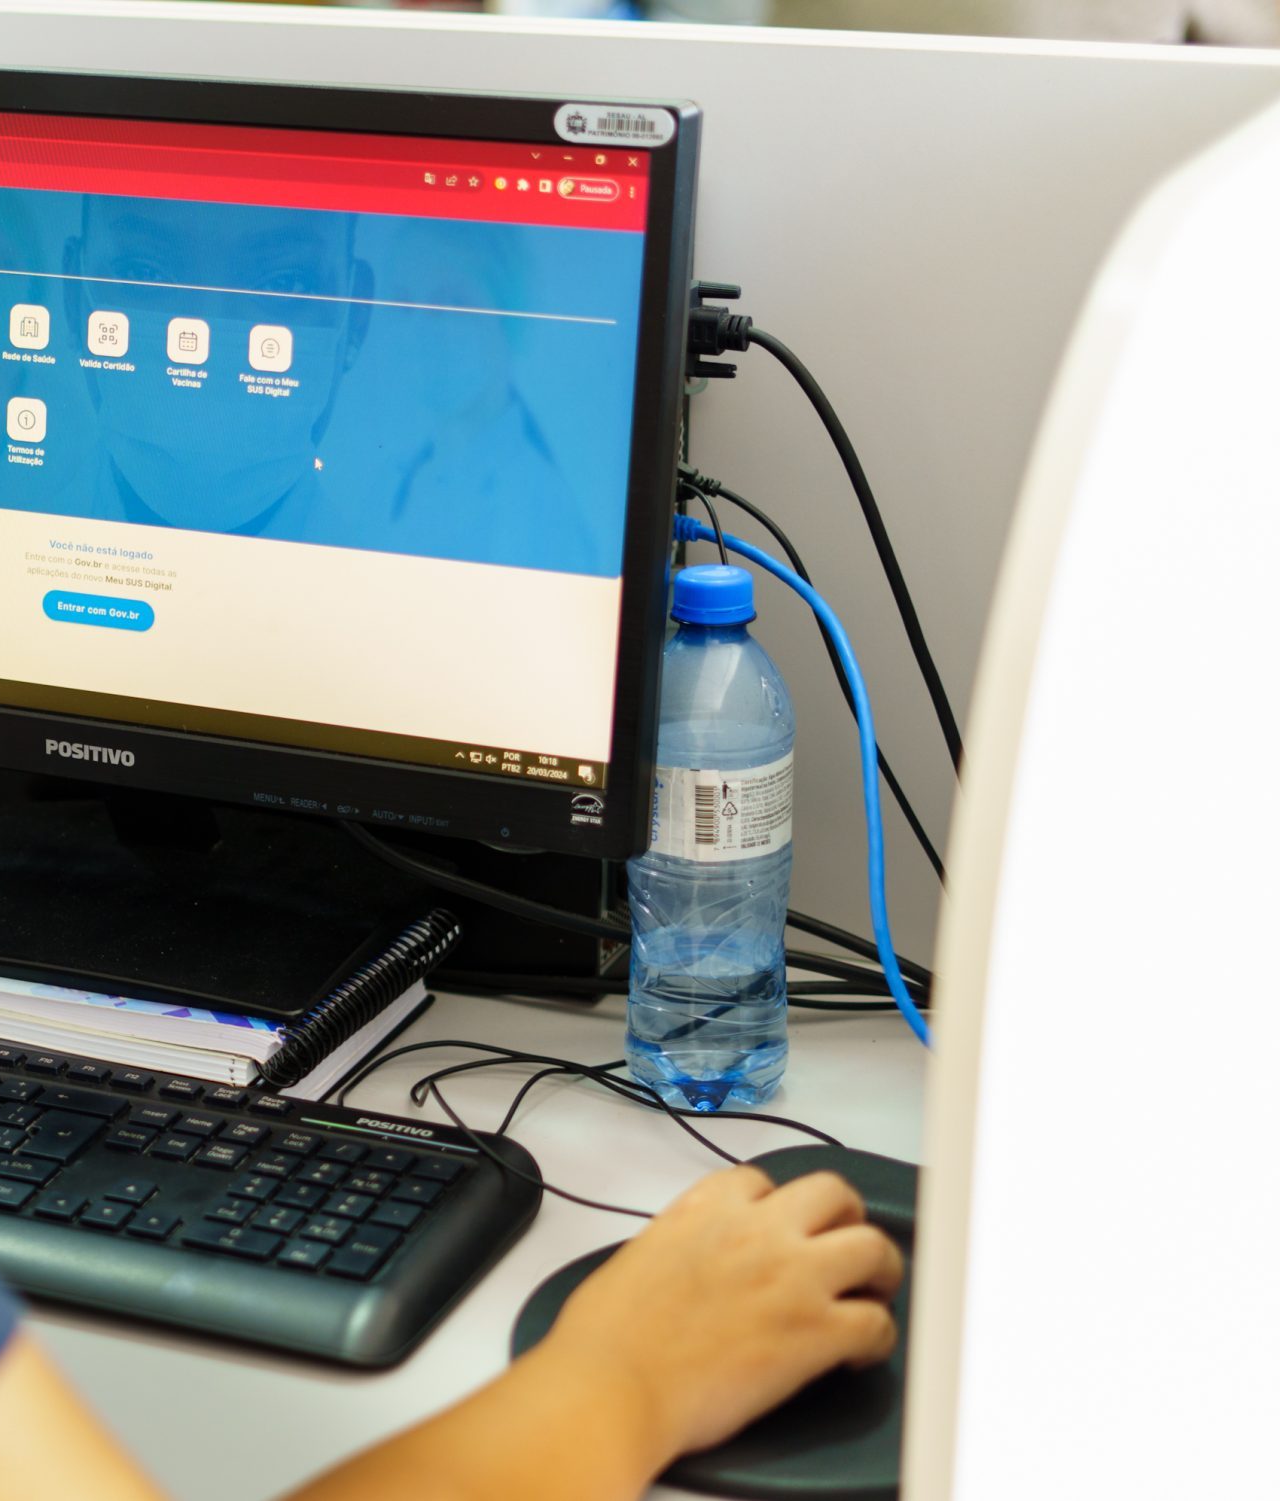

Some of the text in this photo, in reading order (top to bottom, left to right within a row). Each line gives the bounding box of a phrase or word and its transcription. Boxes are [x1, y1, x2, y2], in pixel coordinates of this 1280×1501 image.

[580, 183, 612, 196] Pausada
[2, 352, 56, 365] Rede de Saúde
[79, 358, 135, 372] Valida Certidão
[166, 367, 208, 379] Cartilha de
[172, 378, 201, 388] Vacinas
[239, 374, 256, 384] Fale
[257, 377, 274, 386] com
[282, 378, 300, 388] Meu
[247, 385, 290, 398] SUS Digital
[8, 445, 45, 457] Termos de
[8, 455, 44, 467] Utilização
[49, 540, 154, 562] Você não está logado
[24, 552, 178, 578] Entre com o Gov.br e acesse todas as
[26, 566, 70, 580] aplicações
[71, 570, 82, 580] do
[83, 573, 104, 583] novo
[105, 576, 124, 586] Meu
[126, 578, 143, 588] SUS
[57, 601, 140, 620] Entrar com Gov.br
[46, 738, 134, 767] POSITIVO
[504, 752, 558, 766] POR 10:18
[502, 762, 568, 780] PTB2 20/03/2024
[218, 1087, 240, 1096] Scroll
[142, 1109, 168, 1118] Insert
[186, 1118, 213, 1128] Home
[238, 1124, 260, 1134] Page
[356, 1117, 434, 1138] POSITIVO
[118, 1130, 146, 1140] Delete
[232, 1128, 246, 1136] Up
[290, 1132, 312, 1142] Num
[168, 1139, 187, 1148] End
[283, 1138, 305, 1148] Lock
[256, 1162, 284, 1172] Home
[352, 1241, 379, 1254] Enter
